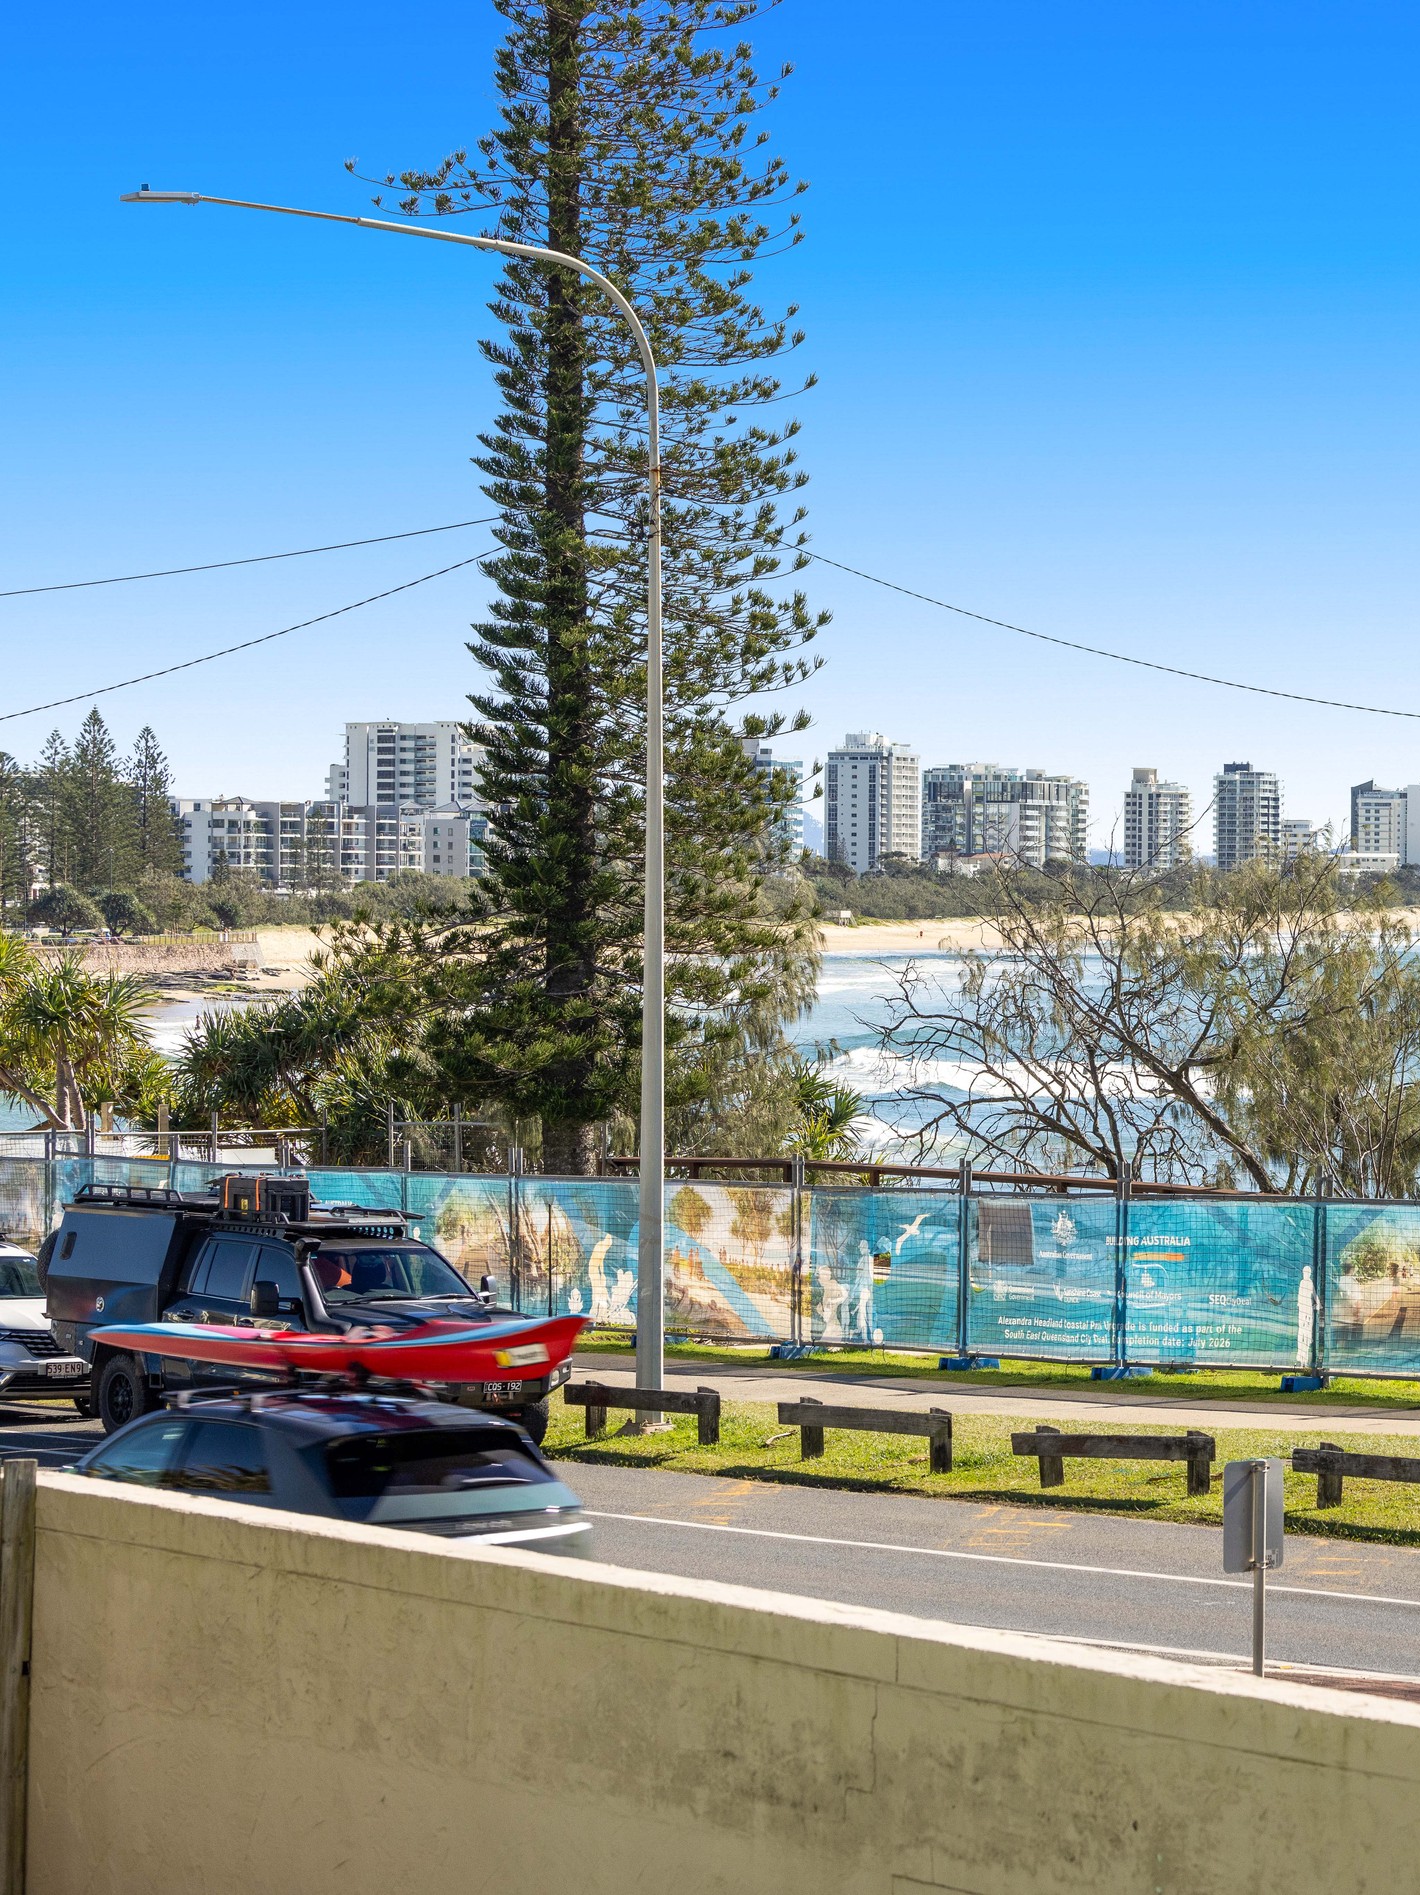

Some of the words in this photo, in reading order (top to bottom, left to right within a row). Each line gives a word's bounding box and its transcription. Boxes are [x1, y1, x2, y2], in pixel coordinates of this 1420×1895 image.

[1141, 1236, 1191, 1246] AUSTRALIA
[1145, 1291, 1154, 1299] of
[998, 1316, 1032, 1326] Alexandra
[1034, 1317, 1062, 1328] Headland
[1138, 1322, 1147, 1331] is
[1149, 1322, 1179, 1333] funded
[1182, 1325, 1193, 1333] as
[1196, 1325, 1213, 1335] part
[1216, 1325, 1227, 1334] of
[1228, 1325, 1242, 1334] the
[1004, 1329, 1025, 1339] South
[1162, 1336, 1185, 1347] date:
[1208, 1338, 1231, 1347] 2026
